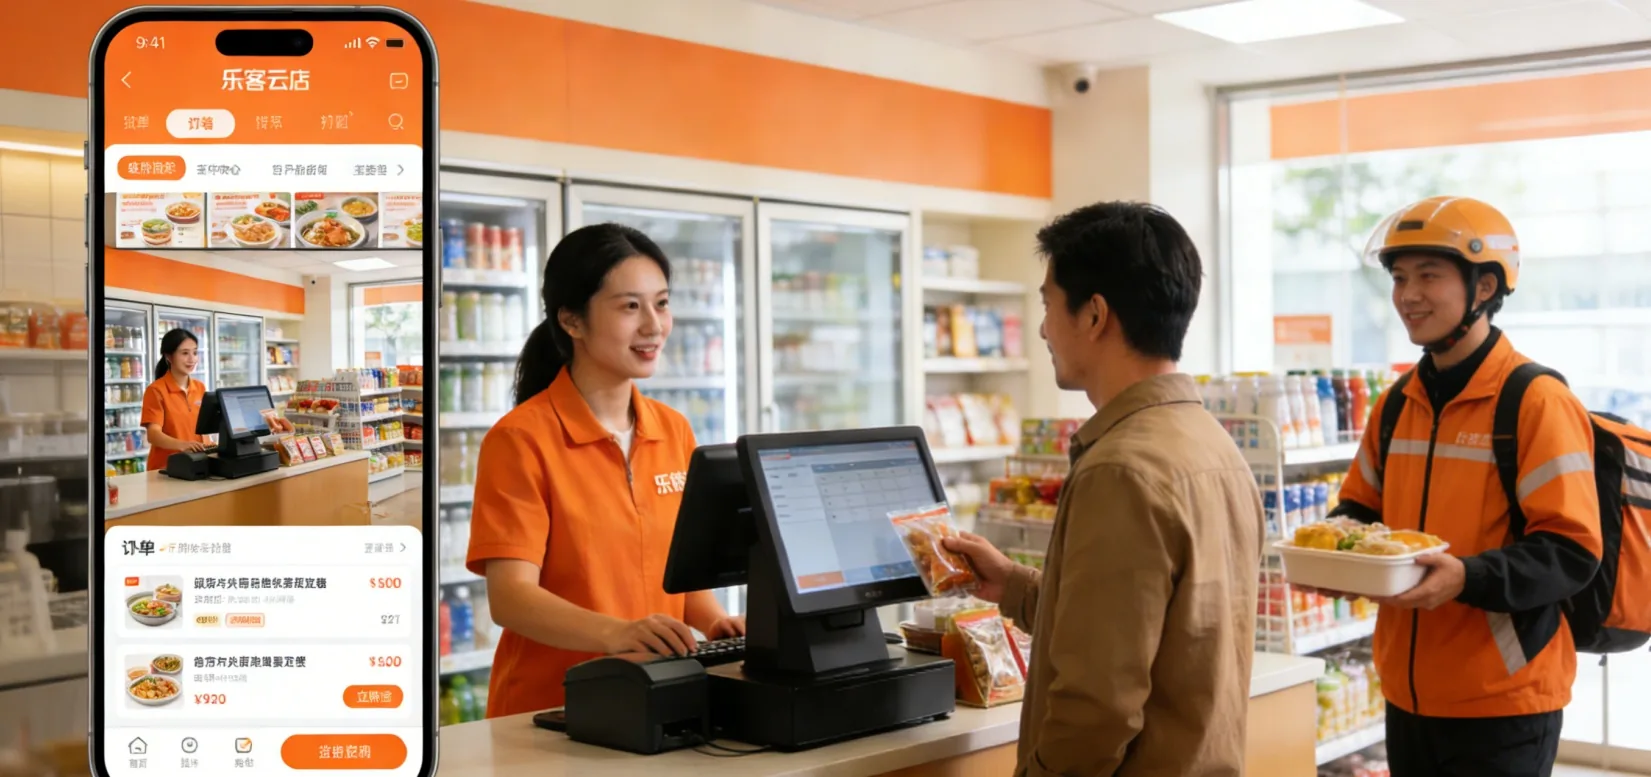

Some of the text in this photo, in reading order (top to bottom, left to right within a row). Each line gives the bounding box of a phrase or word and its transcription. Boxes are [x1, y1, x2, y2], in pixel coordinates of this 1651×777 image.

[136, 36, 165, 49] 9:41
[221, 68, 310, 91] 乐客云店
